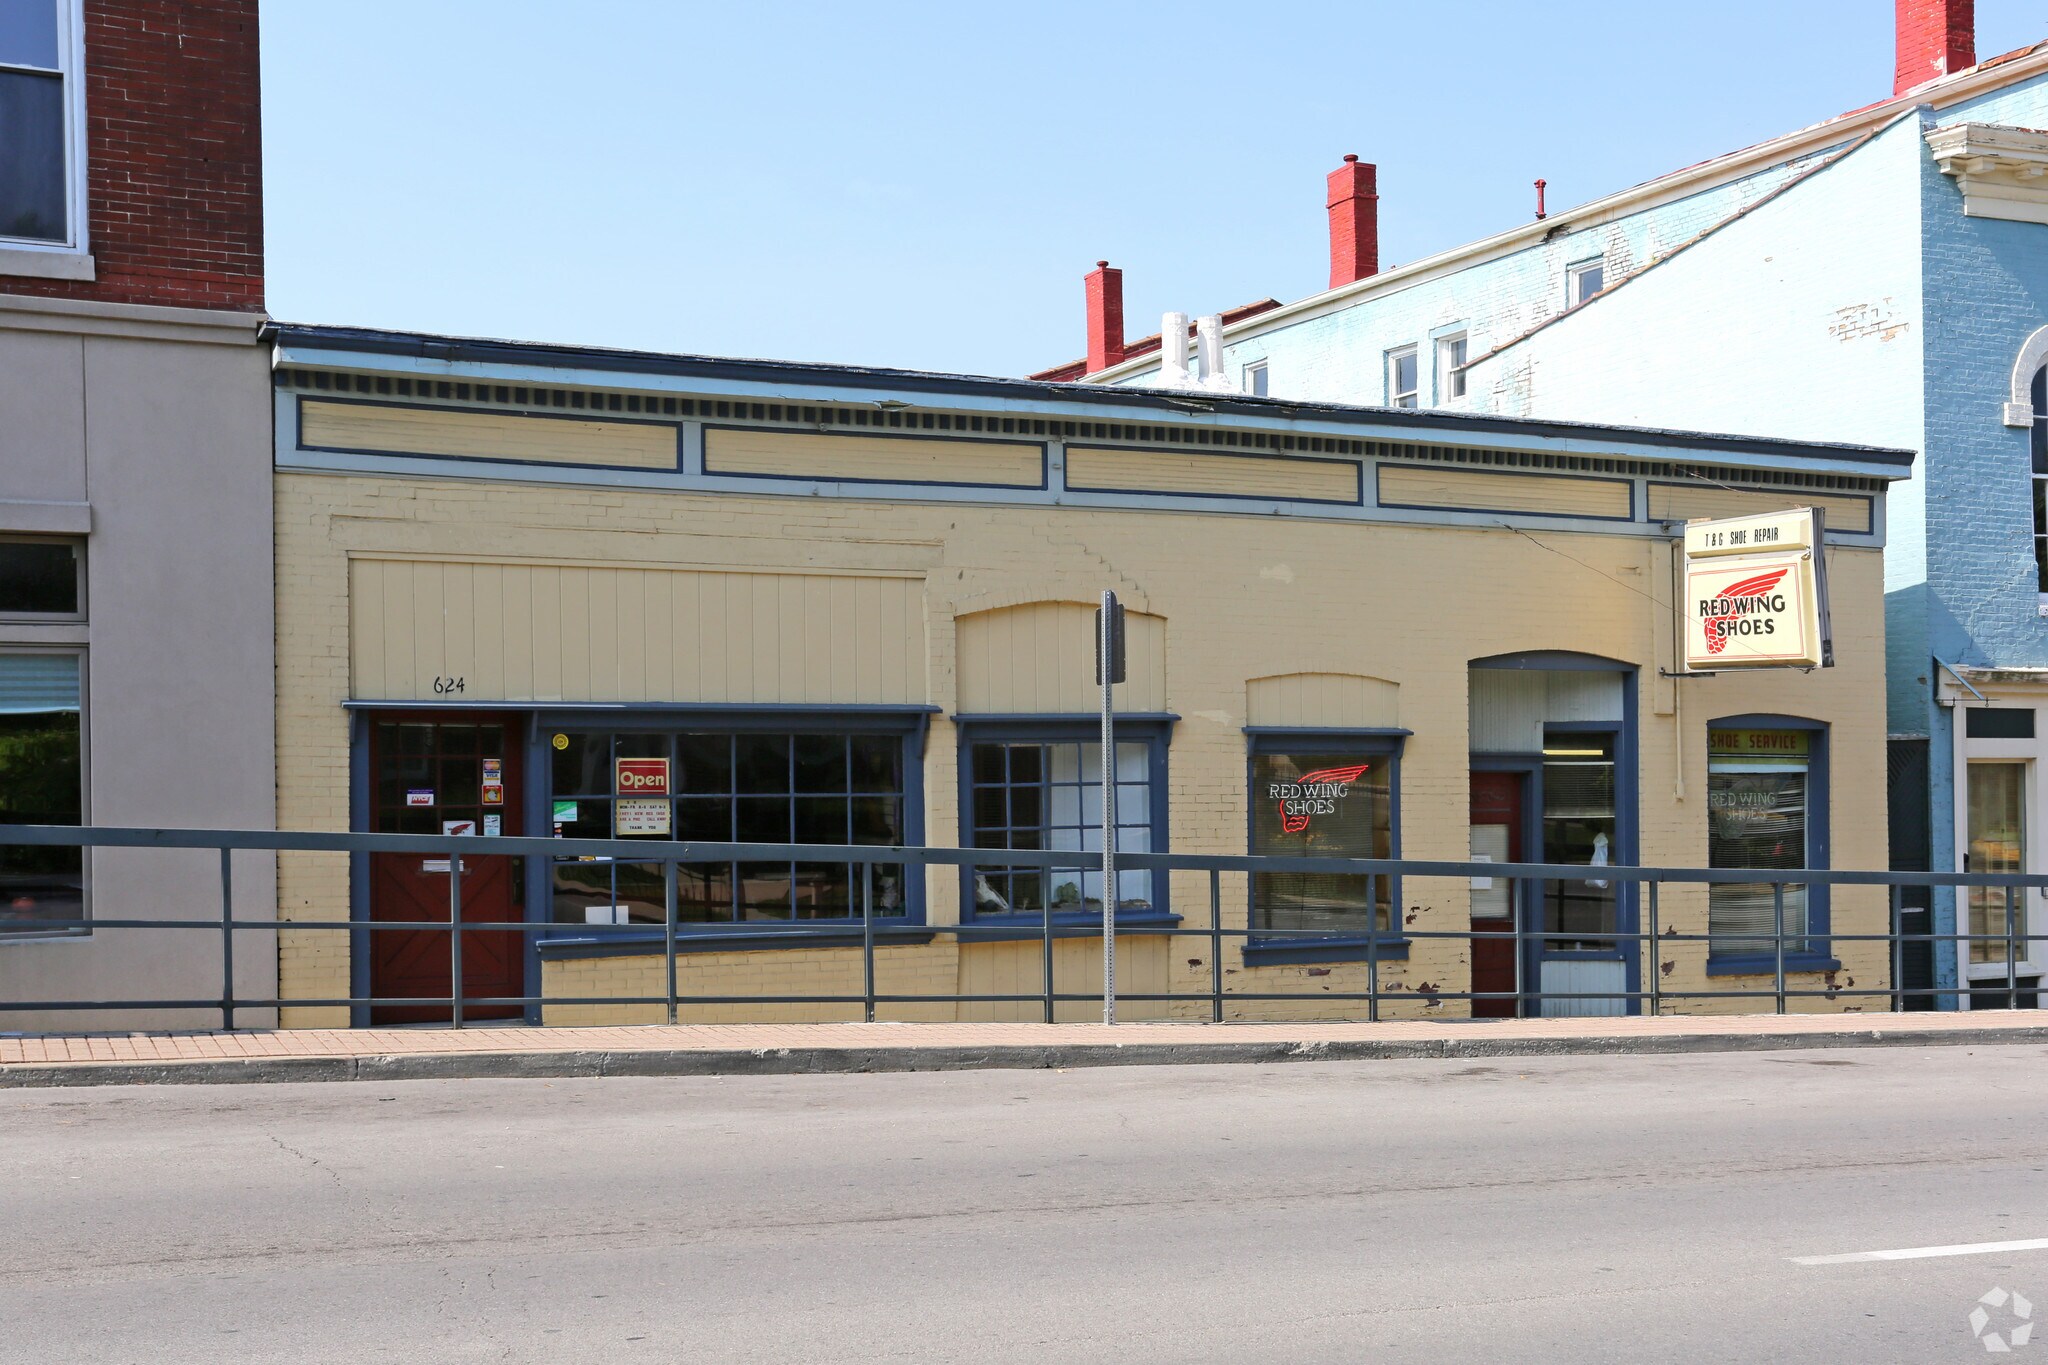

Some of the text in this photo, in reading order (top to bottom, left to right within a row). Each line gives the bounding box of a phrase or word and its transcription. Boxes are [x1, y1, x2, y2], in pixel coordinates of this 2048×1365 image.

[1705, 533, 1709, 547] T
[1711, 533, 1716, 546] &
[1730, 530, 1747, 545] SHOE
[1754, 527, 1779, 543] REPAIR
[1699, 594, 1786, 617] RED WING
[1716, 618, 1775, 637] SHOES
[433, 676, 465, 694] 624
[1710, 733, 1797, 750] SHOE SERVICE
[619, 771, 665, 789] Open
[1269, 783, 1349, 798] RED WING
[1286, 799, 1335, 815] SHOES
[1710, 792, 1777, 807] RED WING
[1726, 806, 1767, 821] SHOES
